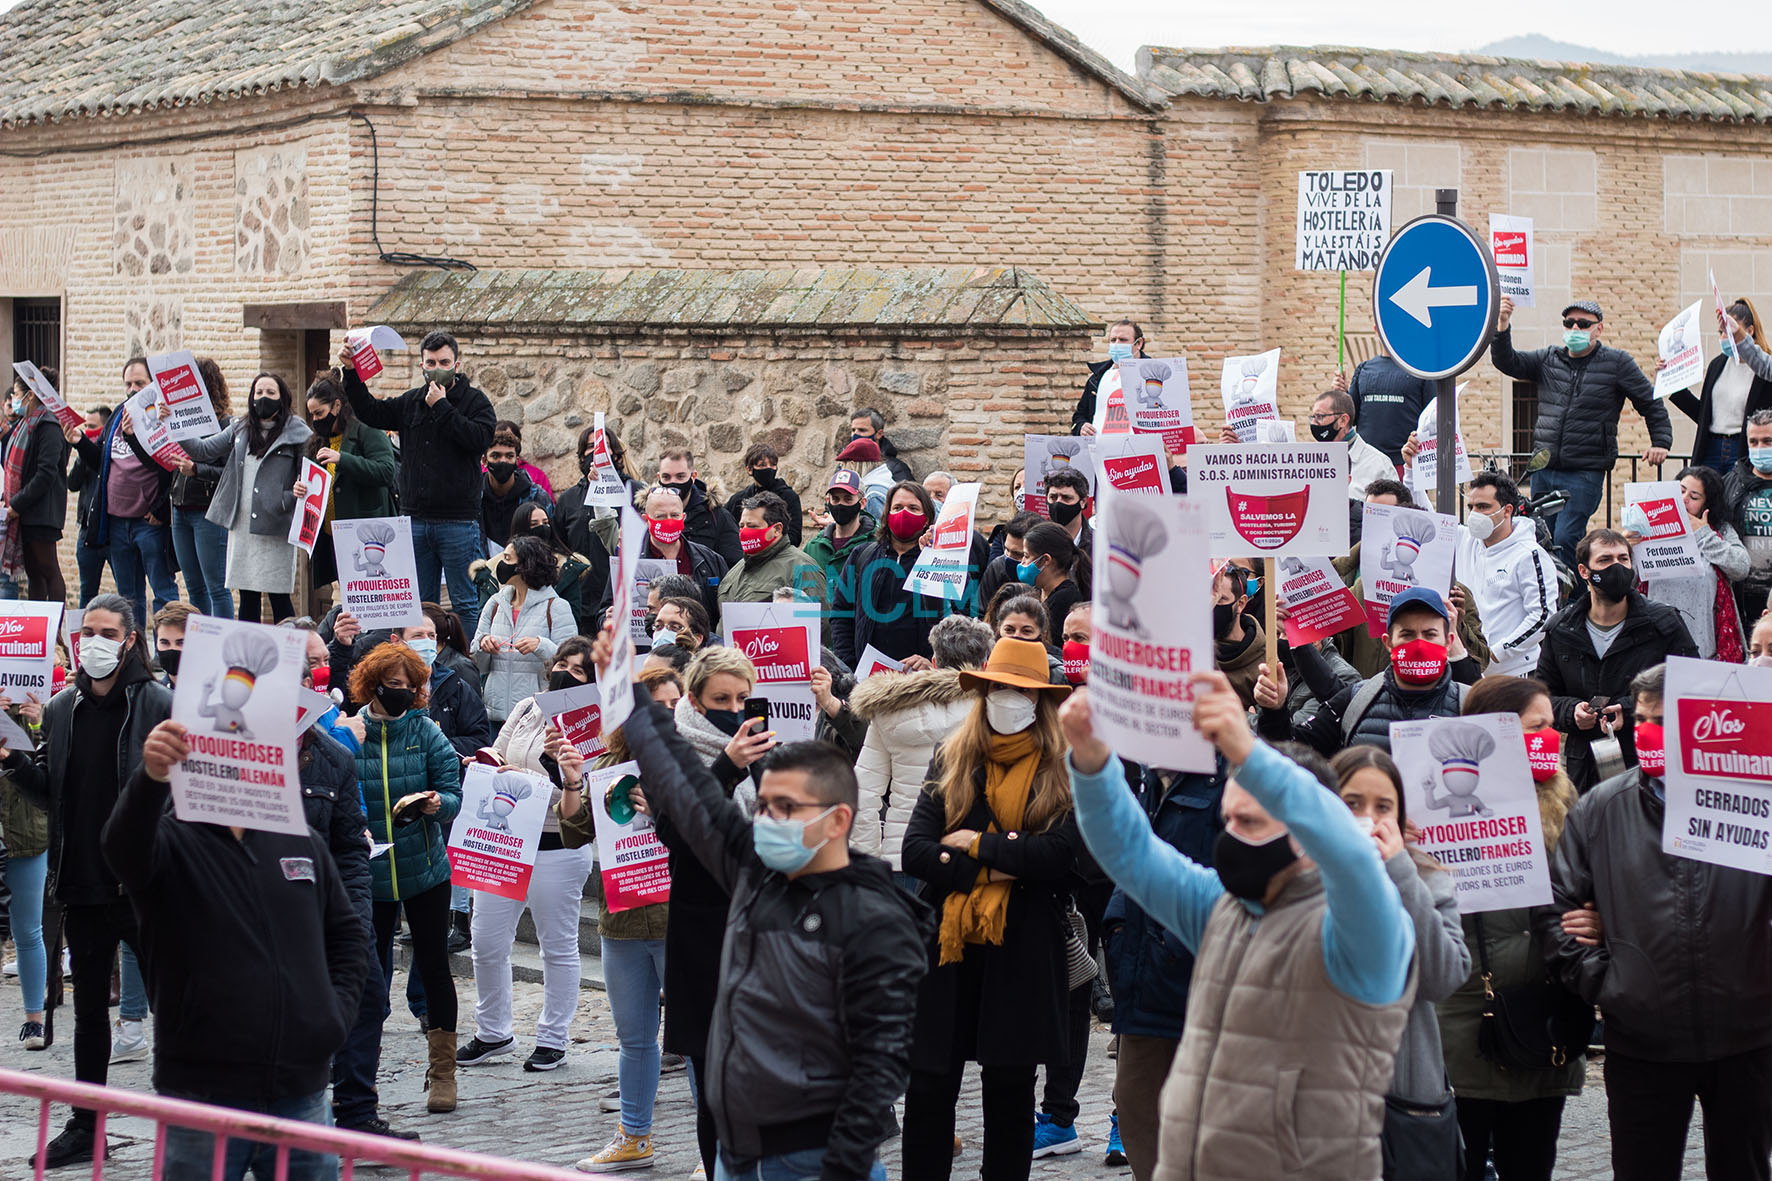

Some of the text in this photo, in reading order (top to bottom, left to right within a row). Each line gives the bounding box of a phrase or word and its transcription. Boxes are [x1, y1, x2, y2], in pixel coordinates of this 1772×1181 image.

[1306, 172, 1382, 192] TOLEDO
[1345, 193, 1359, 207] DE
[1366, 192, 1382, 207] LA
[1304, 236, 1311, 248] Y
[1302, 250, 1380, 270] MATANDO
[174, 406, 203, 418] Perdonen
[170, 414, 212, 430] las molestias
[1205, 453, 1330, 465] VAMOS HACIA LA RUINA
[1107, 461, 1153, 482] Sin ayudas
[1200, 468, 1336, 481] S.O.S. ADMINISTRACIONES
[594, 486, 605, 494] las
[1238, 501, 1247, 512] #
[1647, 503, 1673, 519] ayudas
[1646, 546, 1683, 557] Perdonen
[931, 557, 959, 570] Perdonen
[1641, 556, 1695, 569] las molestias
[916, 568, 962, 585] las molestias
[1282, 569, 1326, 593] #YOQUIEROSER
[347, 578, 410, 592] #YOQUIEROSER
[1287, 581, 1332, 603] HOSTELEROFRANCÉS
[348, 591, 412, 604] HOSTELEROFRANCÉS
[746, 635, 779, 659] Nos
[1397, 648, 1406, 659] #
[754, 662, 806, 680] rruinan!
[1397, 660, 1441, 668] SALVEMOSLA
[1399, 667, 1440, 675] HOSTELERÍA
[1, 673, 45, 687] AYUDAS
[768, 702, 811, 720] AYUDAS
[575, 711, 600, 731] ayudas
[1693, 710, 1745, 739] Nos
[1530, 737, 1544, 751] #
[181, 760, 285, 787] HOSTELEROALEMÁN
[1696, 789, 1770, 818] CERRADOS
[466, 827, 523, 848] #YOQUIEROSER
[1417, 816, 1527, 846] #YOQUIEROSER
[1688, 817, 1712, 839] SIN
[1715, 822, 1769, 850] AYUDAS
[463, 839, 521, 859] HOSTELEROFRANCÉS
[1452, 861, 1533, 879] MILLONES DE EUROS
[1482, 877, 1492, 889] AL
[1494, 875, 1525, 887] SECTOR
